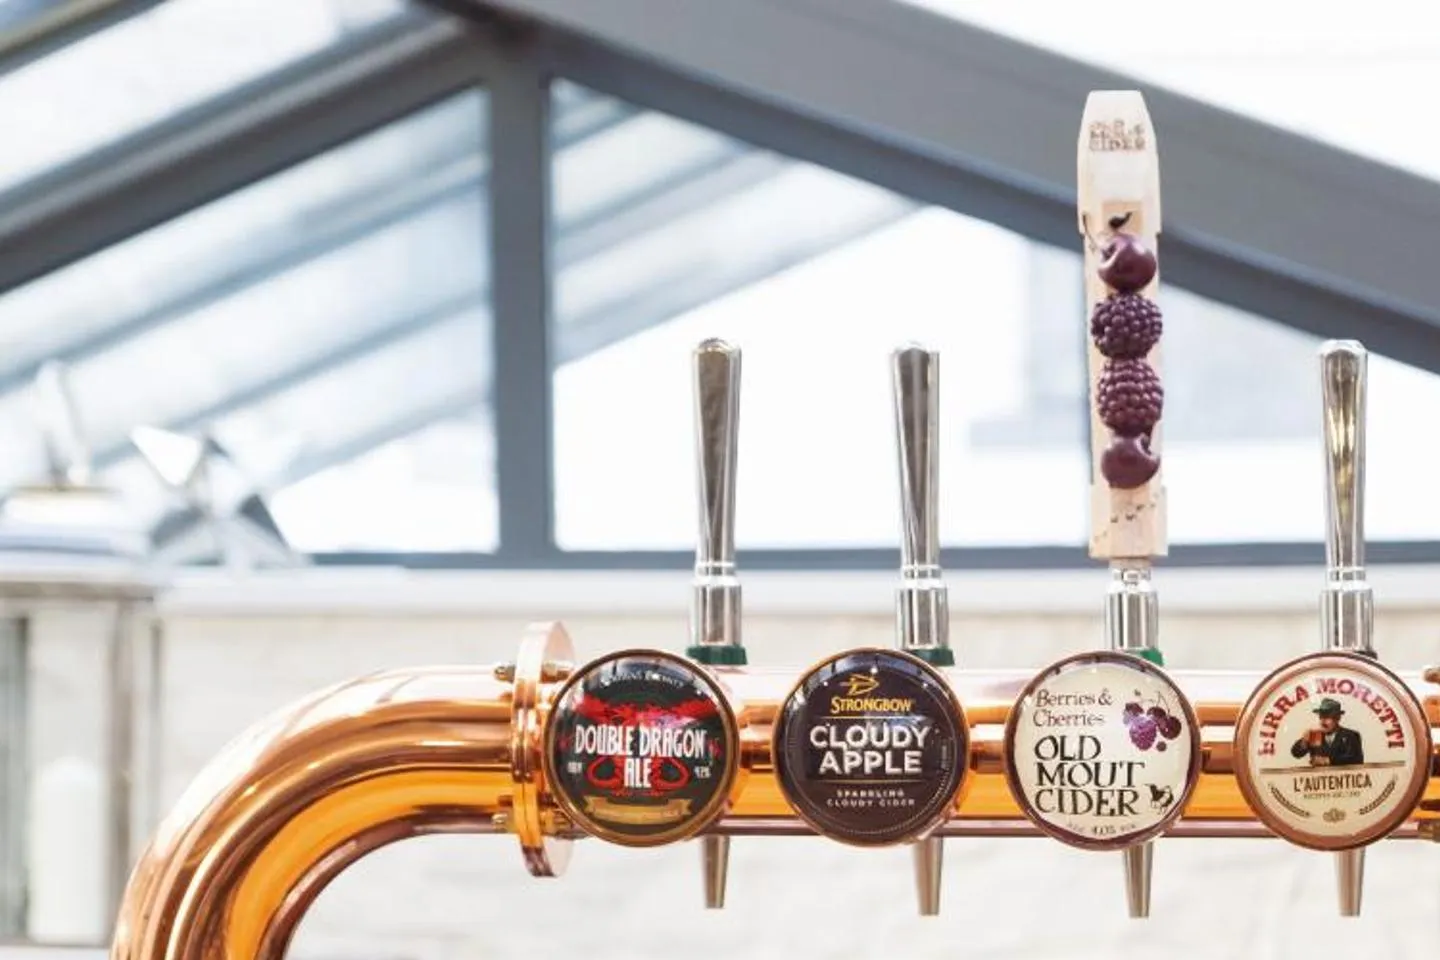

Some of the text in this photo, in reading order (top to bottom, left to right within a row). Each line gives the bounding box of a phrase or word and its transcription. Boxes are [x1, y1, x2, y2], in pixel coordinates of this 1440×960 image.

[830, 696, 912, 714] STRONGBOW
[1035, 687, 1113, 708] Berries &
[1033, 708, 1105, 728] Cherries
[575, 724, 708, 759] DOUBLE DRAGON
[809, 724, 932, 750] CLOUDY
[1034, 734, 1102, 762] OLD
[623, 757, 653, 788] ALE
[818, 750, 923, 775] APPLE
[1034, 761, 1146, 788] MOUT
[1293, 772, 1374, 793] L'AUTENTICA
[1034, 788, 1141, 817] CIDER
